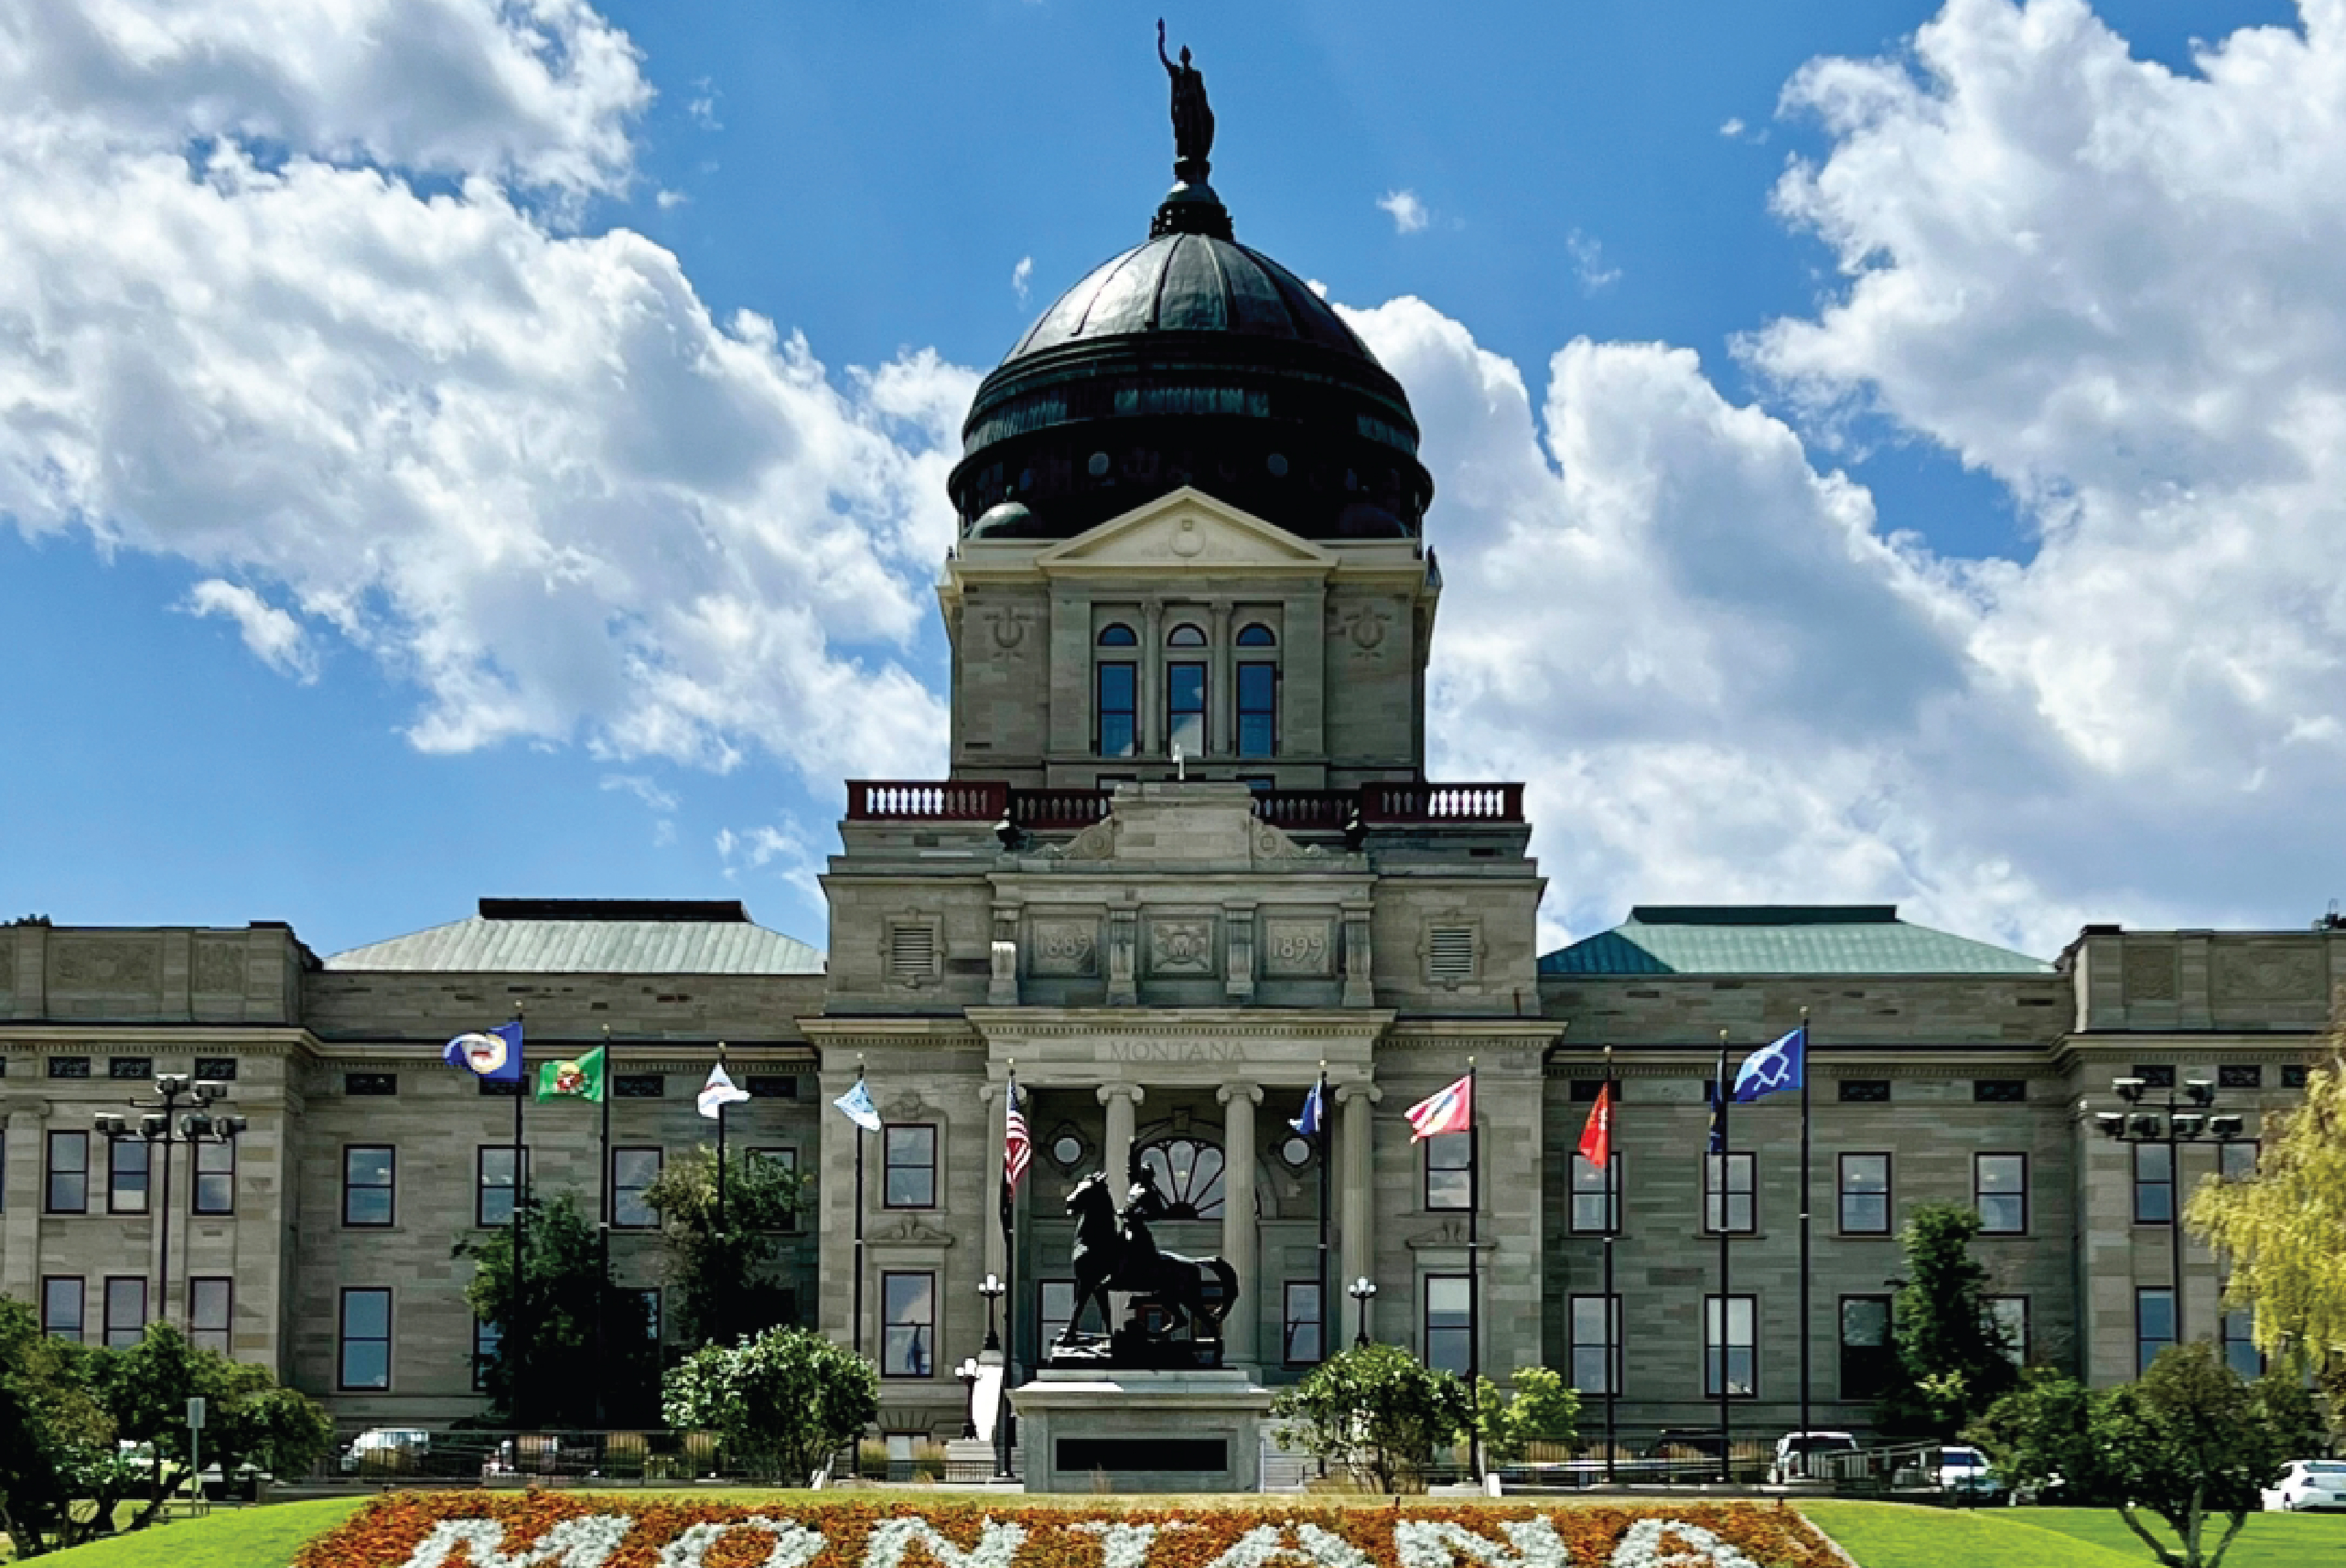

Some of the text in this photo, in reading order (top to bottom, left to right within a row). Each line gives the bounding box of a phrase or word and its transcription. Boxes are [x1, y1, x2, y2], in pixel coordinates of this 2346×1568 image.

[1039, 937, 1090, 962] 1889
[1274, 937, 1323, 962] 1899
[1110, 1040, 1247, 1060] MONTANA
